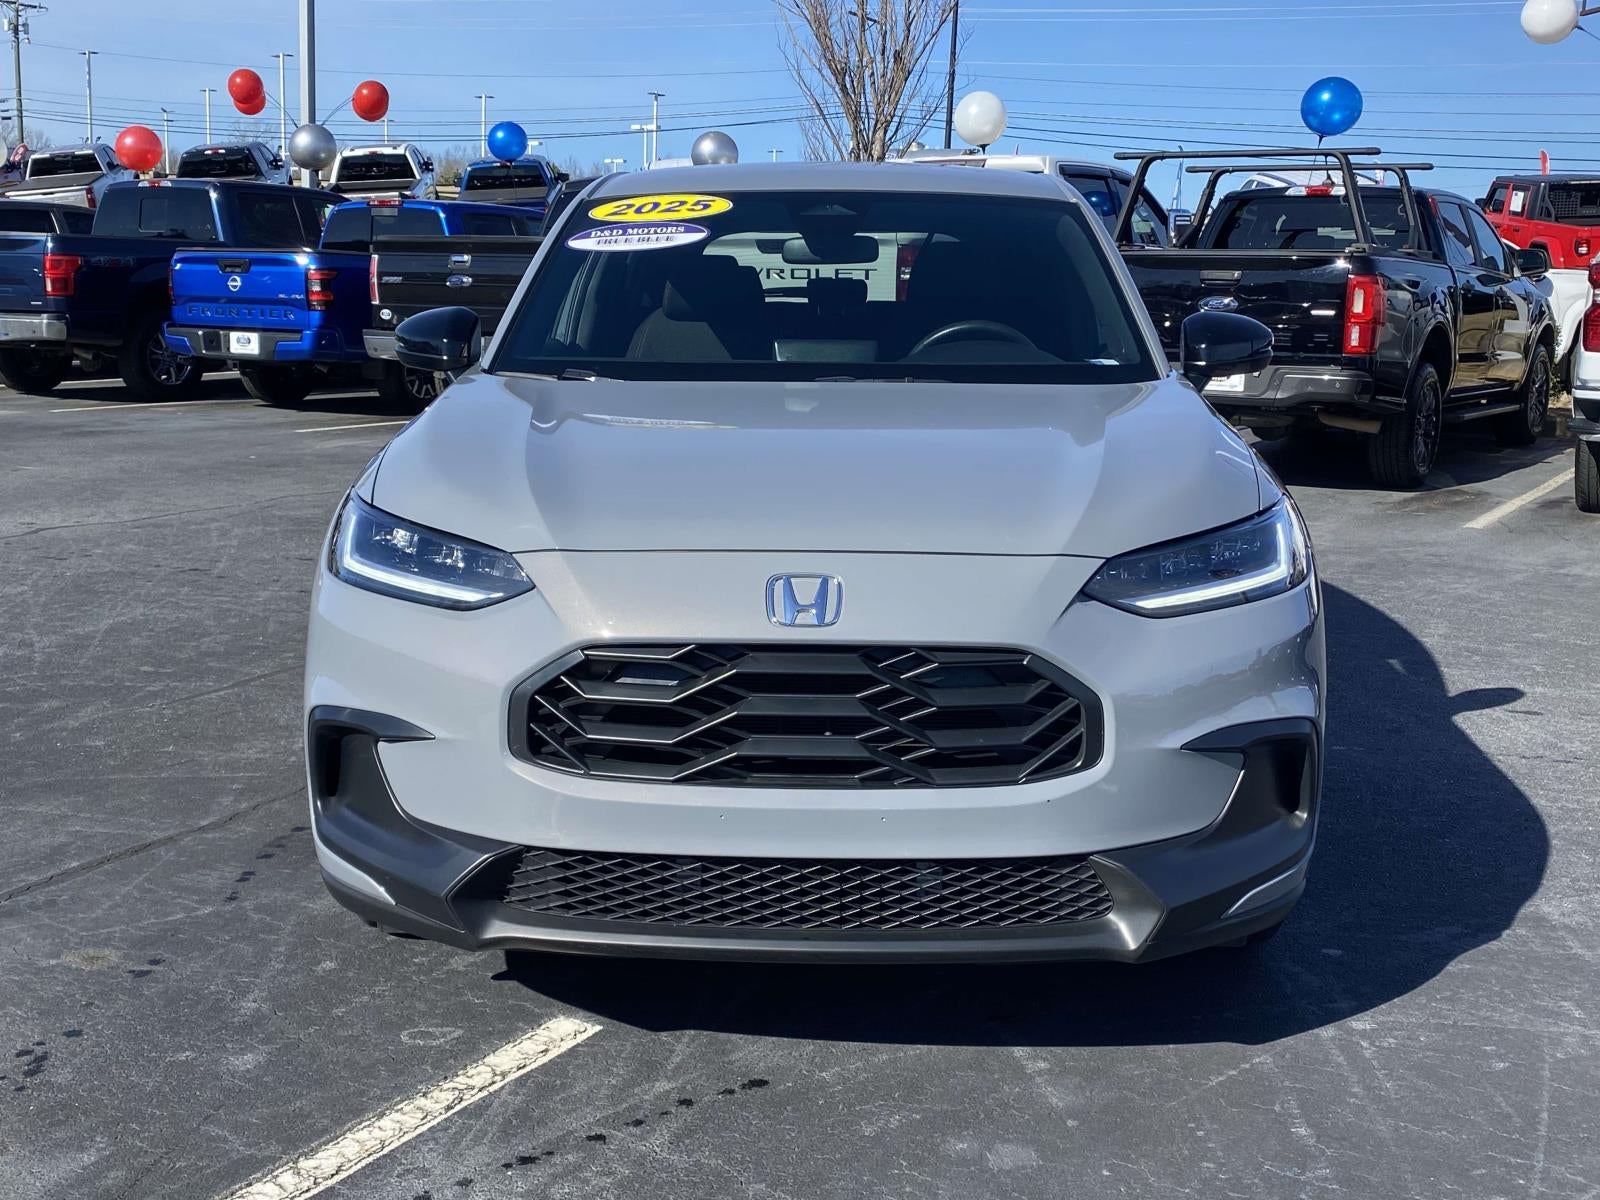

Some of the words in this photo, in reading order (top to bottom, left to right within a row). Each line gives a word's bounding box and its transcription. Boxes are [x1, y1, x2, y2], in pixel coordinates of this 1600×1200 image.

[603, 200, 716, 217] 2025
[590, 228, 624, 238] D&D
[623, 226, 686, 237] MOTORS
[637, 234, 676, 244] BLUE
[187, 303, 295, 320] FRONTIER
